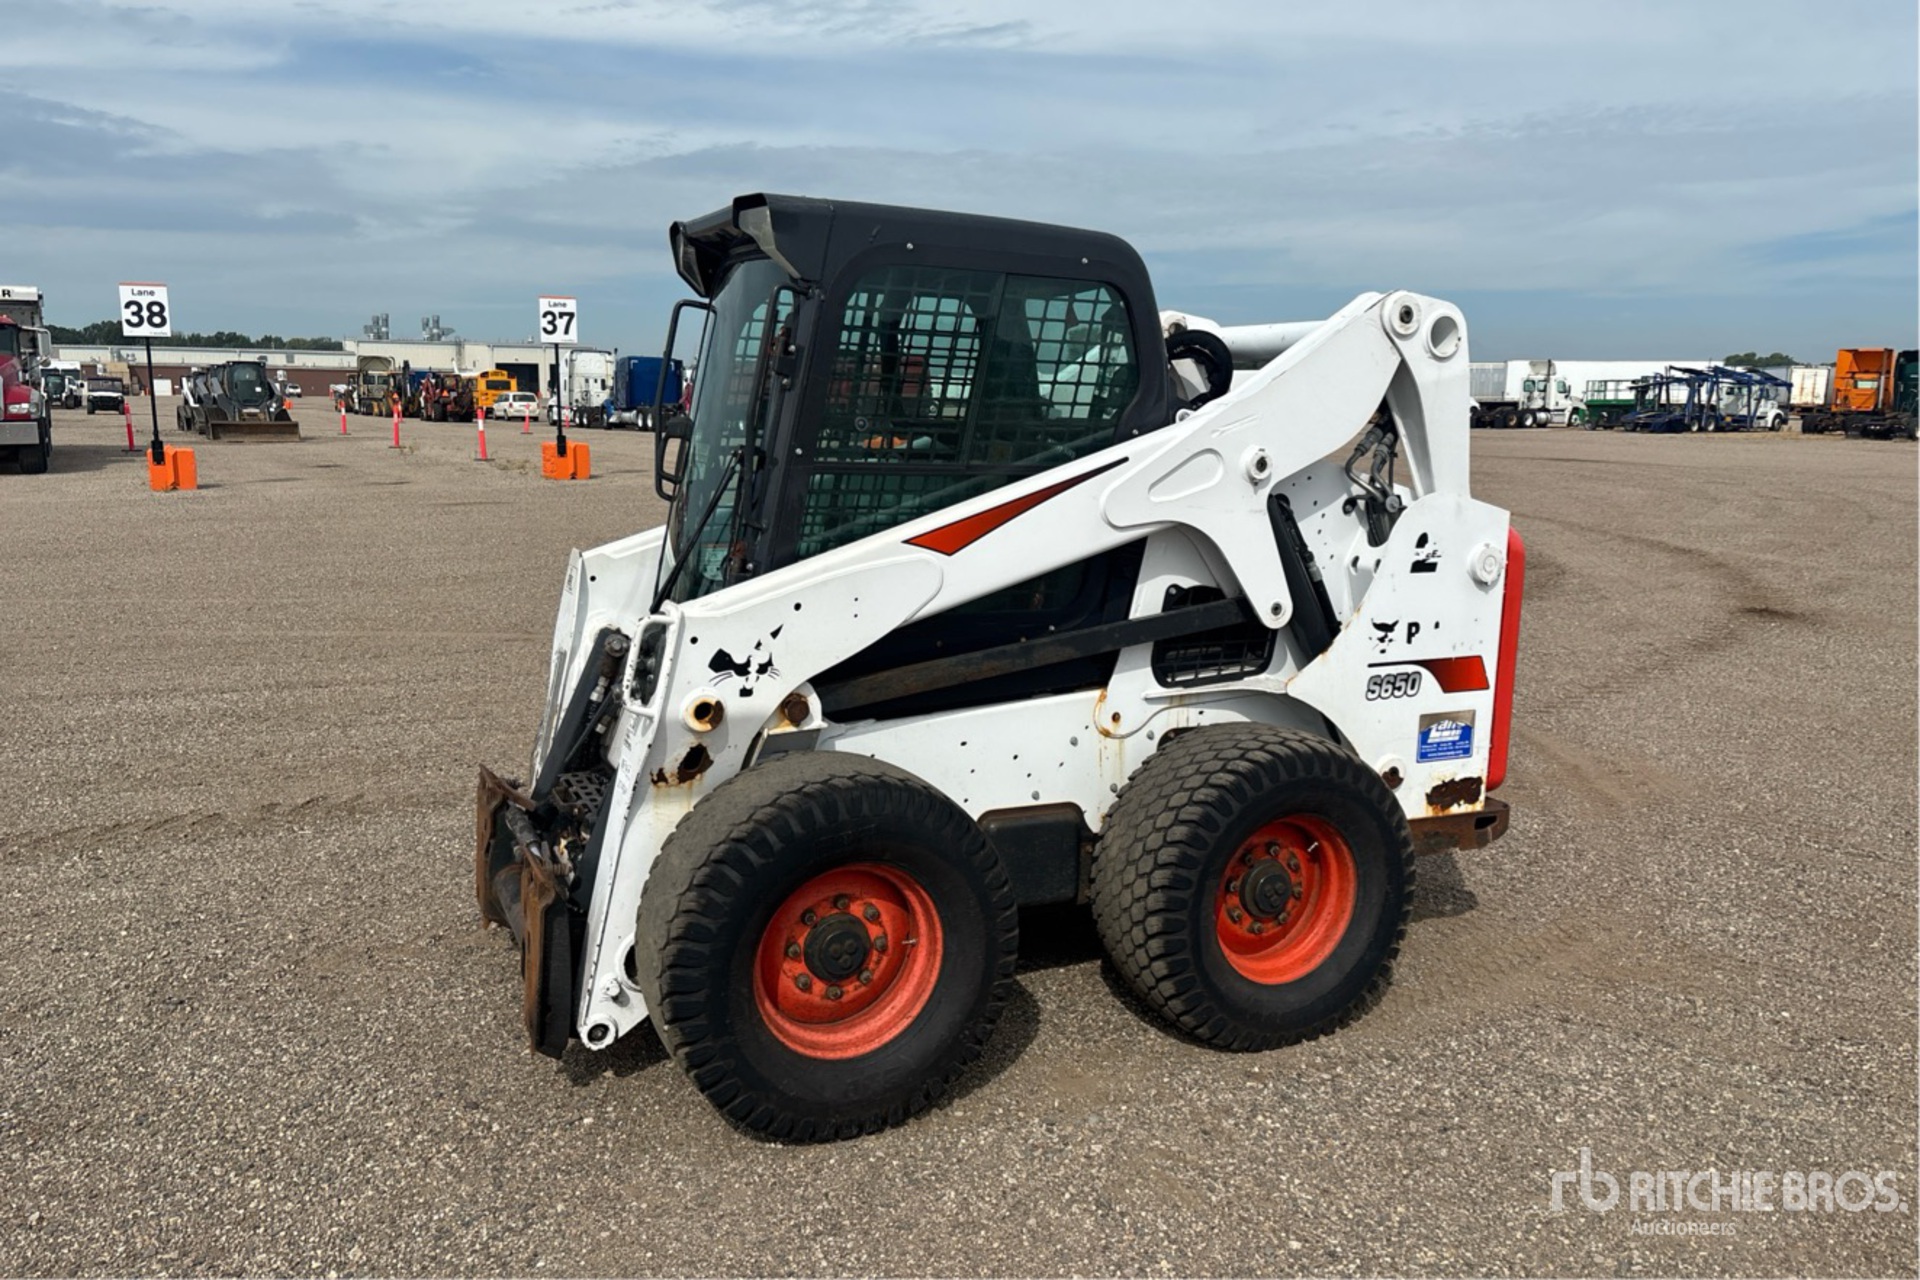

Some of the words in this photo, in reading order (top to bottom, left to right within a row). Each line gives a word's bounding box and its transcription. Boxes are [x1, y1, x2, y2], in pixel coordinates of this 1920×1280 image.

[131, 288, 155, 296] Lane
[548, 300, 567, 308] Lane
[124, 300, 168, 328] 38
[542, 310, 575, 335] 37
[1366, 671, 1422, 701] S650
